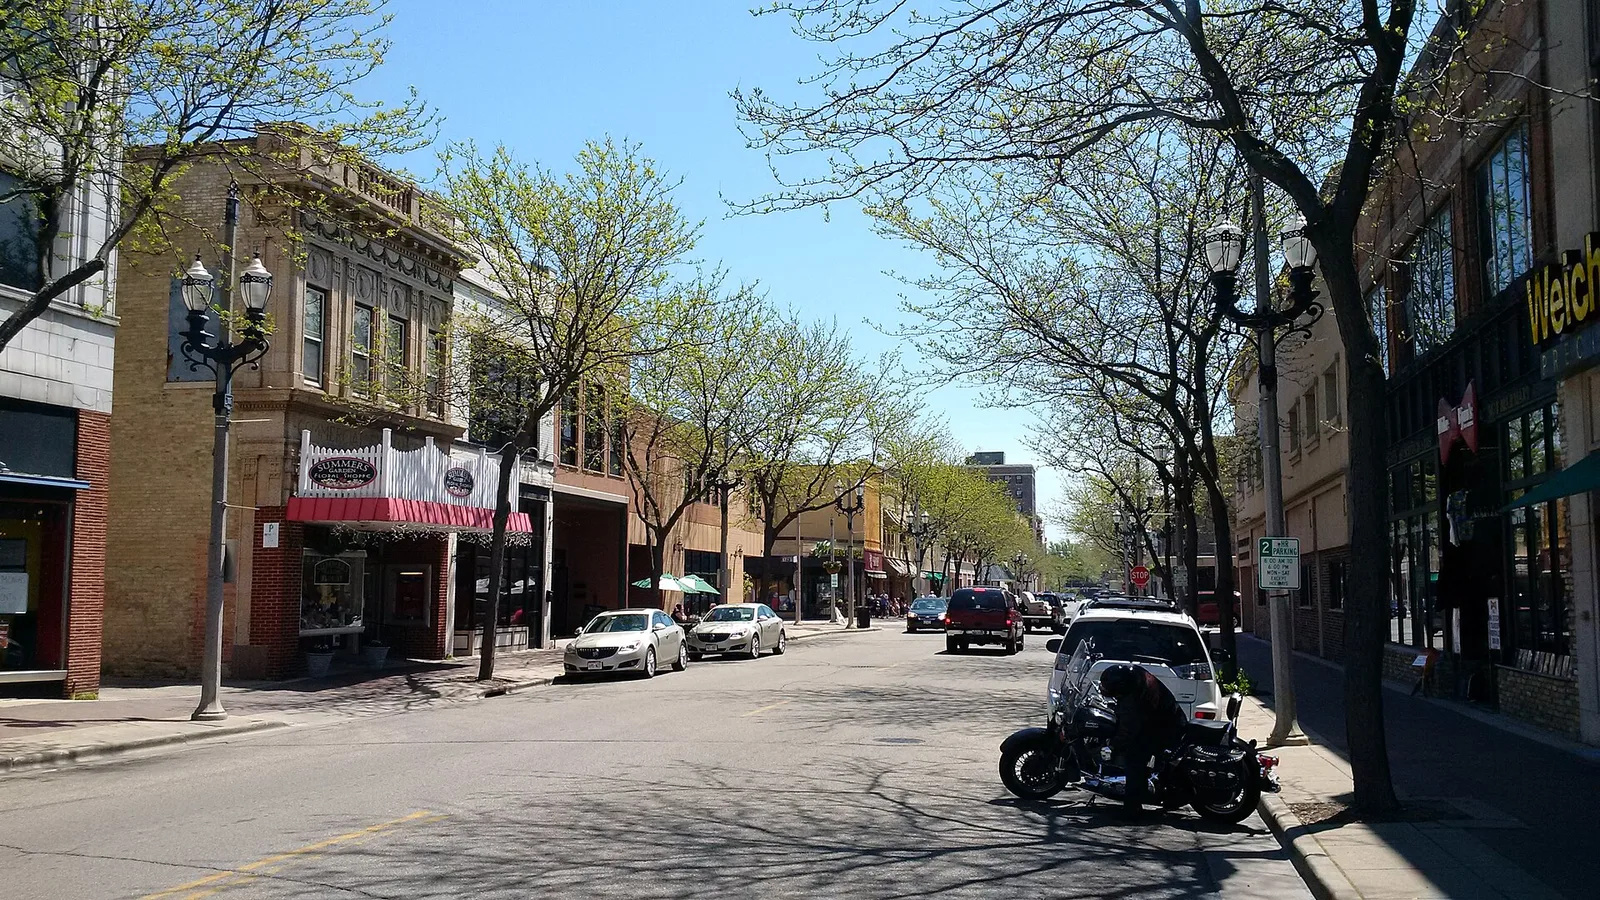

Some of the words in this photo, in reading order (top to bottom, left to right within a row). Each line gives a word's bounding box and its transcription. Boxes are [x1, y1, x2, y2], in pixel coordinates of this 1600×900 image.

[317, 460, 369, 472] SUMMERS
[1262, 541, 1270, 554] 2
[1131, 571, 1149, 579] STOP
